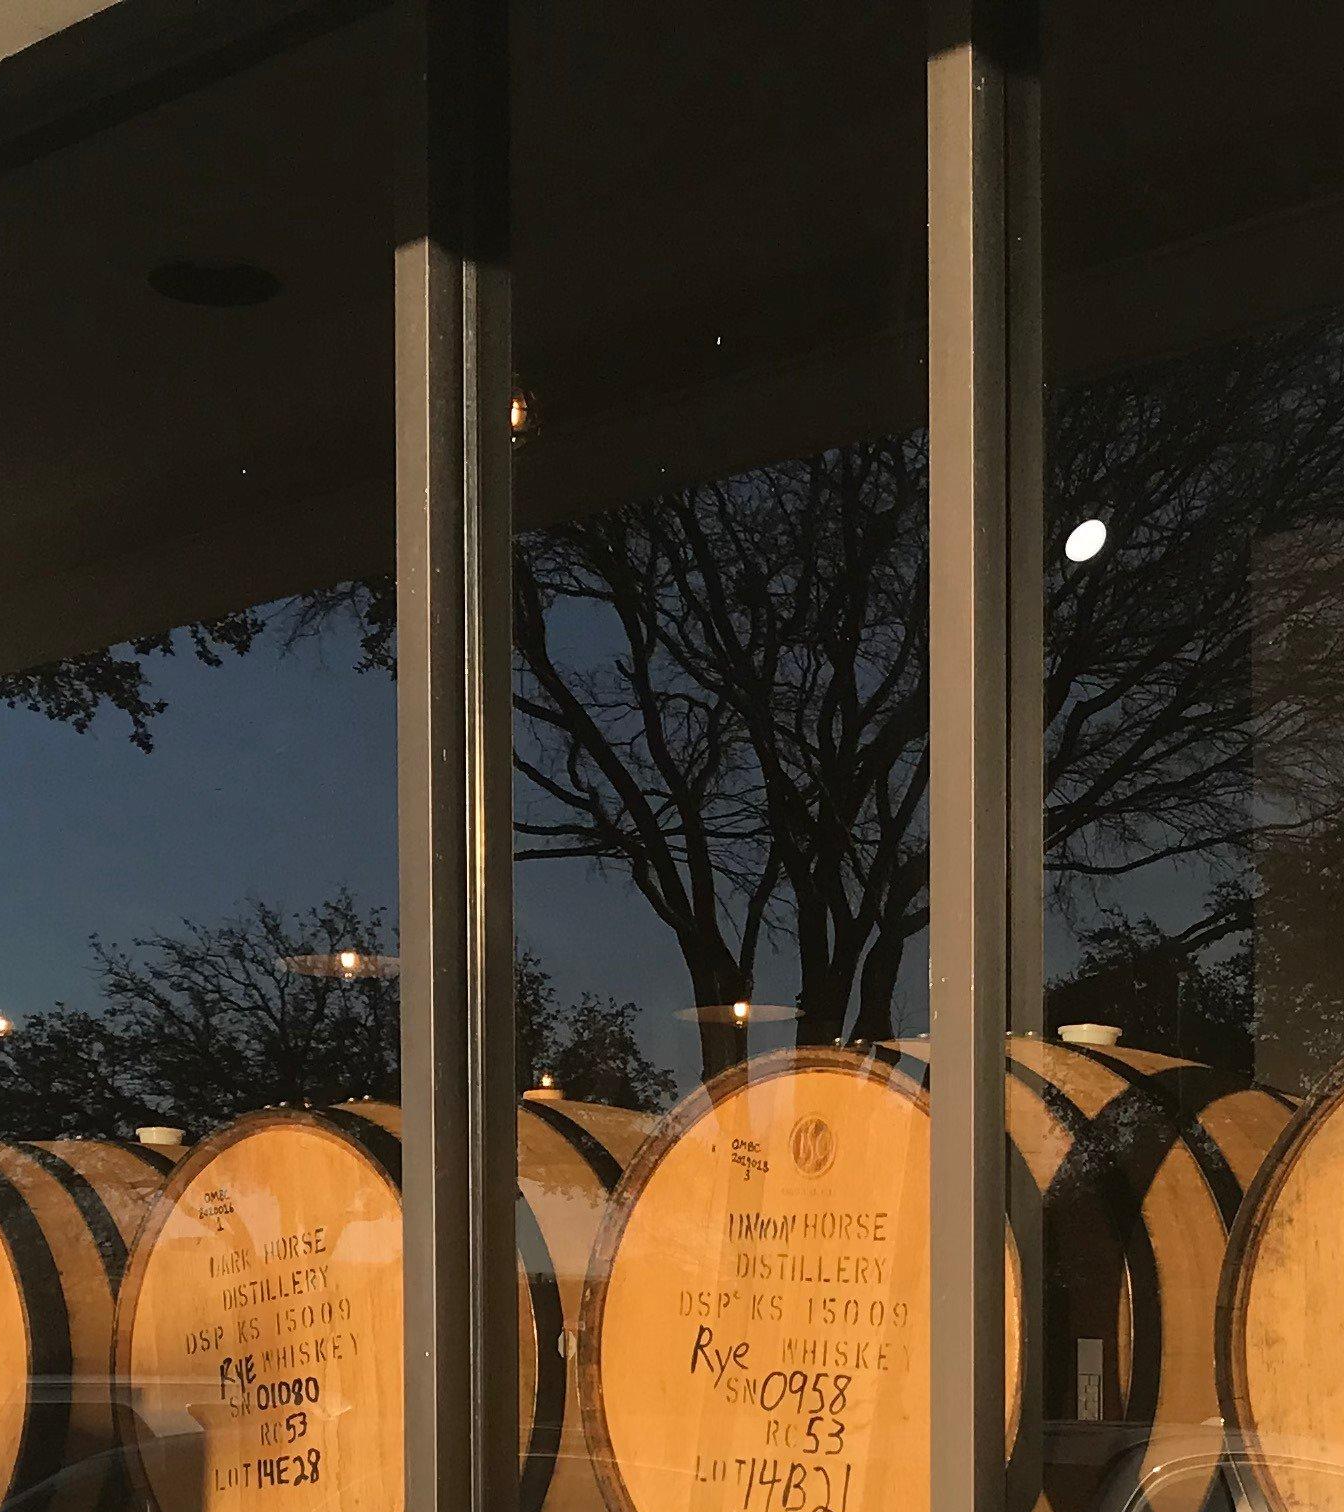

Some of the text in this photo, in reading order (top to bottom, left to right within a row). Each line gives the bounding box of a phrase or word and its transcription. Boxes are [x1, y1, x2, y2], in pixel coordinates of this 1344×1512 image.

[732, 1139, 761, 1153] OMBC
[264, 1228, 326, 1264] HORSE
[729, 1211, 887, 1246] UNION HORSE
[736, 1252, 887, 1283] DISTILLERY
[223, 1265, 328, 1311] DISTILLERY
[186, 1298, 351, 1354] DSP KS 15009
[679, 1291, 908, 1327] DSP KS 15009
[219, 1333, 358, 1399] RYE WHISKEY
[691, 1324, 910, 1389] Rye WHISKEY
[229, 1377, 319, 1418] SN 01080
[726, 1371, 852, 1415] SN 0958
[260, 1412, 307, 1446] RC 53
[766, 1416, 845, 1455] RC 53
[215, 1448, 320, 1491] LOT 14E28
[695, 1455, 746, 1485] LOT
